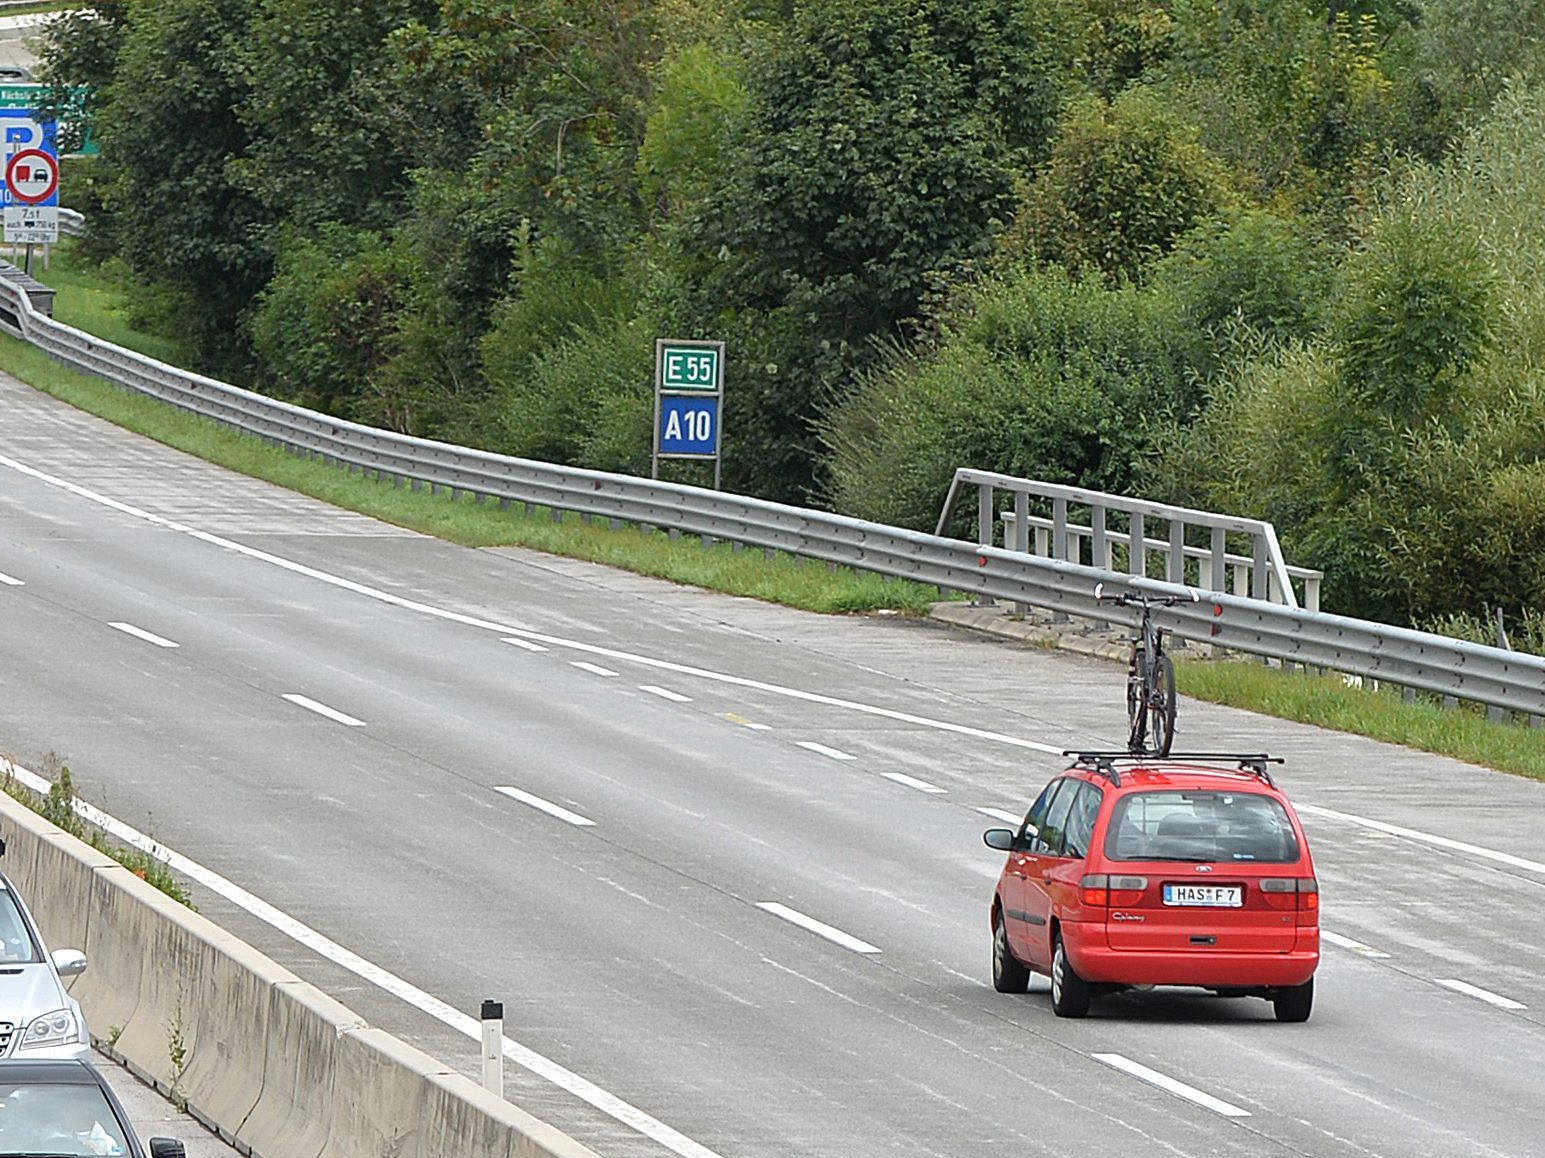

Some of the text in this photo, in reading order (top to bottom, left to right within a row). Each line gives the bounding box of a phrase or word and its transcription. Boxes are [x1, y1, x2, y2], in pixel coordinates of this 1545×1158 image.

[668, 356, 711, 381] E 55
[1177, 888, 1236, 901] HAS F 7
